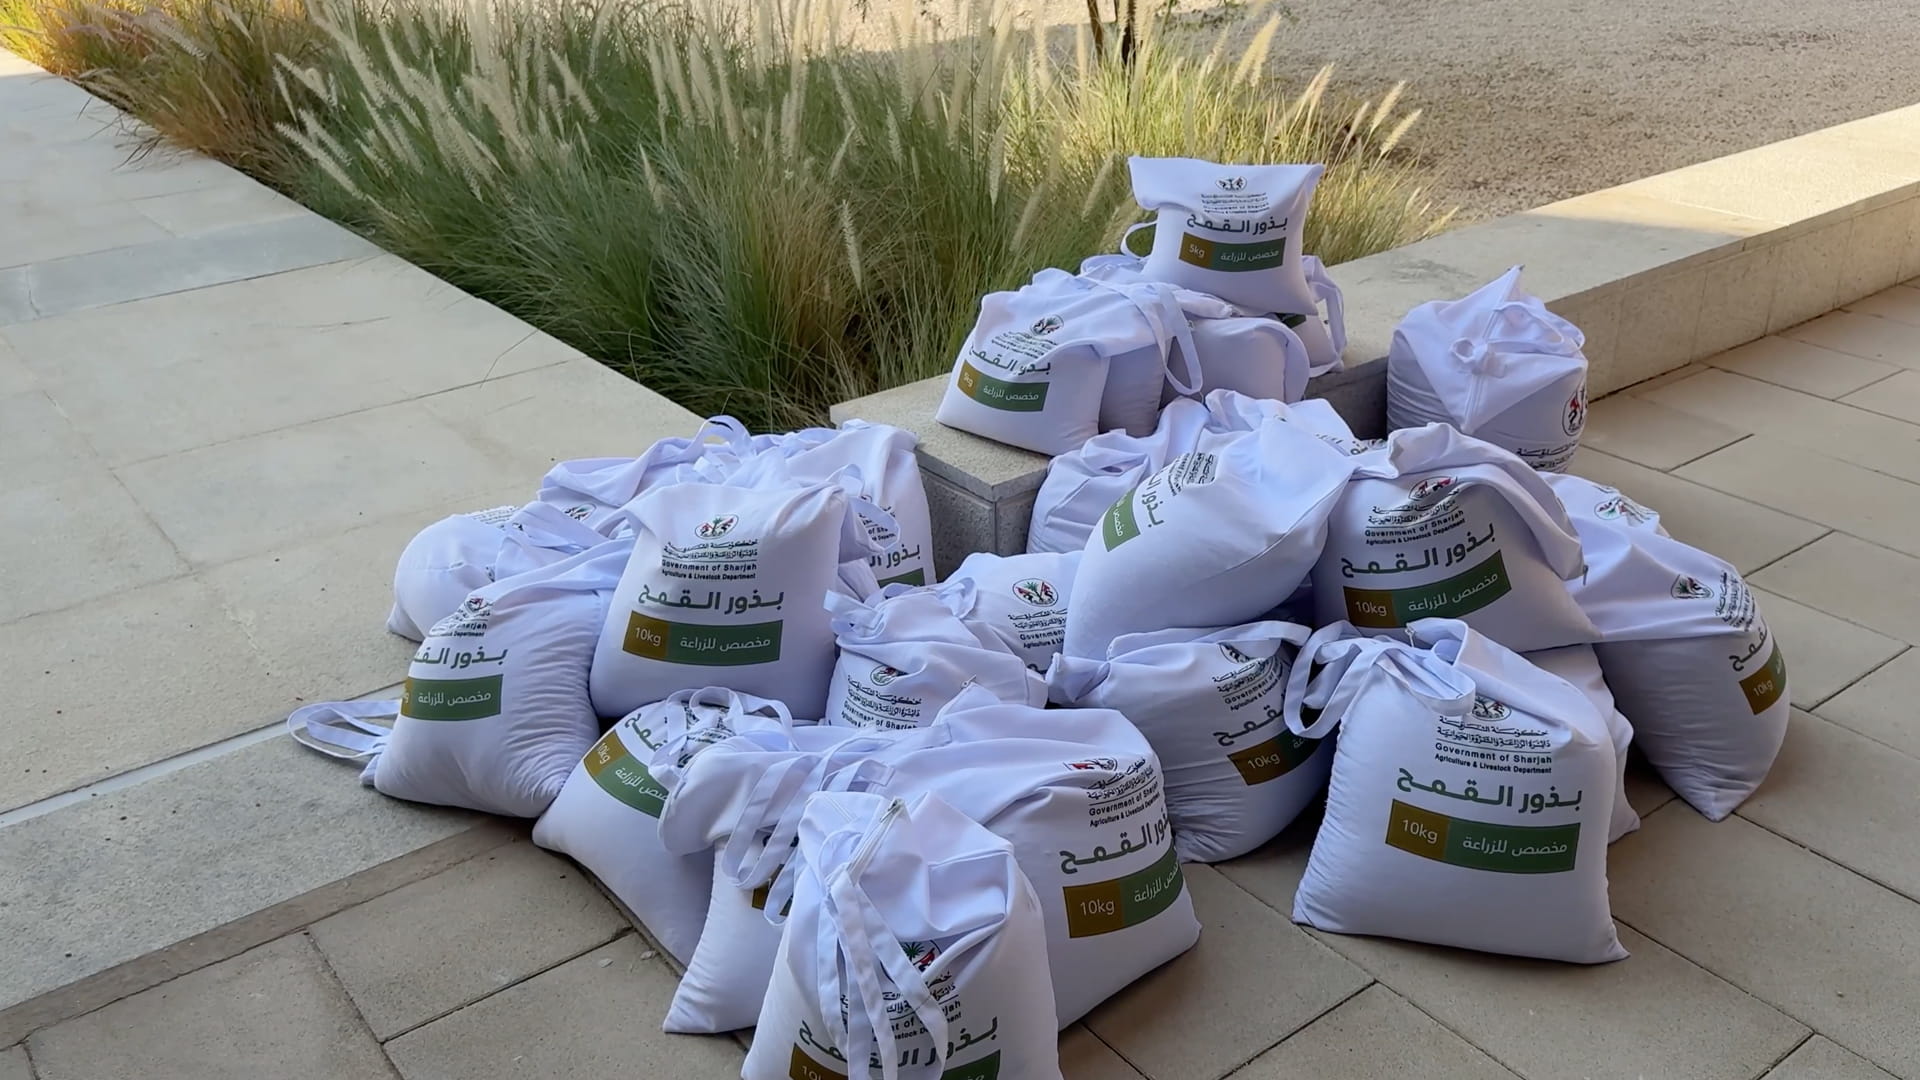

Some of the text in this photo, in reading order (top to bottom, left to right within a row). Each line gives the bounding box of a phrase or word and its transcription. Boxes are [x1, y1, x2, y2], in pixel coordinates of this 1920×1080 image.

[1187, 213, 1288, 235] بذور القمح
[1189, 243, 1205, 258] 5kg
[1220, 250, 1280, 263] مخصص للزراعة
[1006, 391, 1039, 400] مخصص
[1365, 528, 1416, 537] Government
[1431, 510, 1464, 528] Sharjah
[886, 544, 920, 568] بذور
[1341, 523, 1496, 579] بذور القمح
[662, 559, 709, 571] Government
[723, 563, 757, 572] Sharjah
[638, 584, 785, 615] بذور القمح
[1408, 572, 1498, 612] مخصص للزراعة
[1355, 601, 1388, 617] 10kg
[634, 626, 662, 646] 10kg
[680, 636, 771, 652] مخصص للزراعة
[450, 646, 508, 669] بذور
[418, 690, 444, 706] للزراعة
[447, 690, 492, 706] مخصص
[1753, 679, 1774, 697] 10kg
[1213, 704, 1284, 747] قمح
[1248, 753, 1281, 769] 10kg
[1435, 742, 1496, 761] Government
[1513, 755, 1552, 766] Sharjah
[1435, 753, 1471, 767] Agriculture
[1480, 762, 1511, 772] Livestock
[1513, 765, 1552, 774] Department
[616, 767, 644, 787] للزراعة
[1396, 768, 1583, 814] بذور القمح
[1089, 796, 1135, 816] Government
[1136, 792, 1142, 802] of
[1402, 819, 1438, 844] 10kg
[1059, 820, 1152, 874] القمح
[1463, 836, 1567, 857] مخصص للزراعة
[1134, 876, 1162, 903] للزراعة
[1080, 899, 1115, 916] 10kg
[904, 1017, 914, 1027] of
